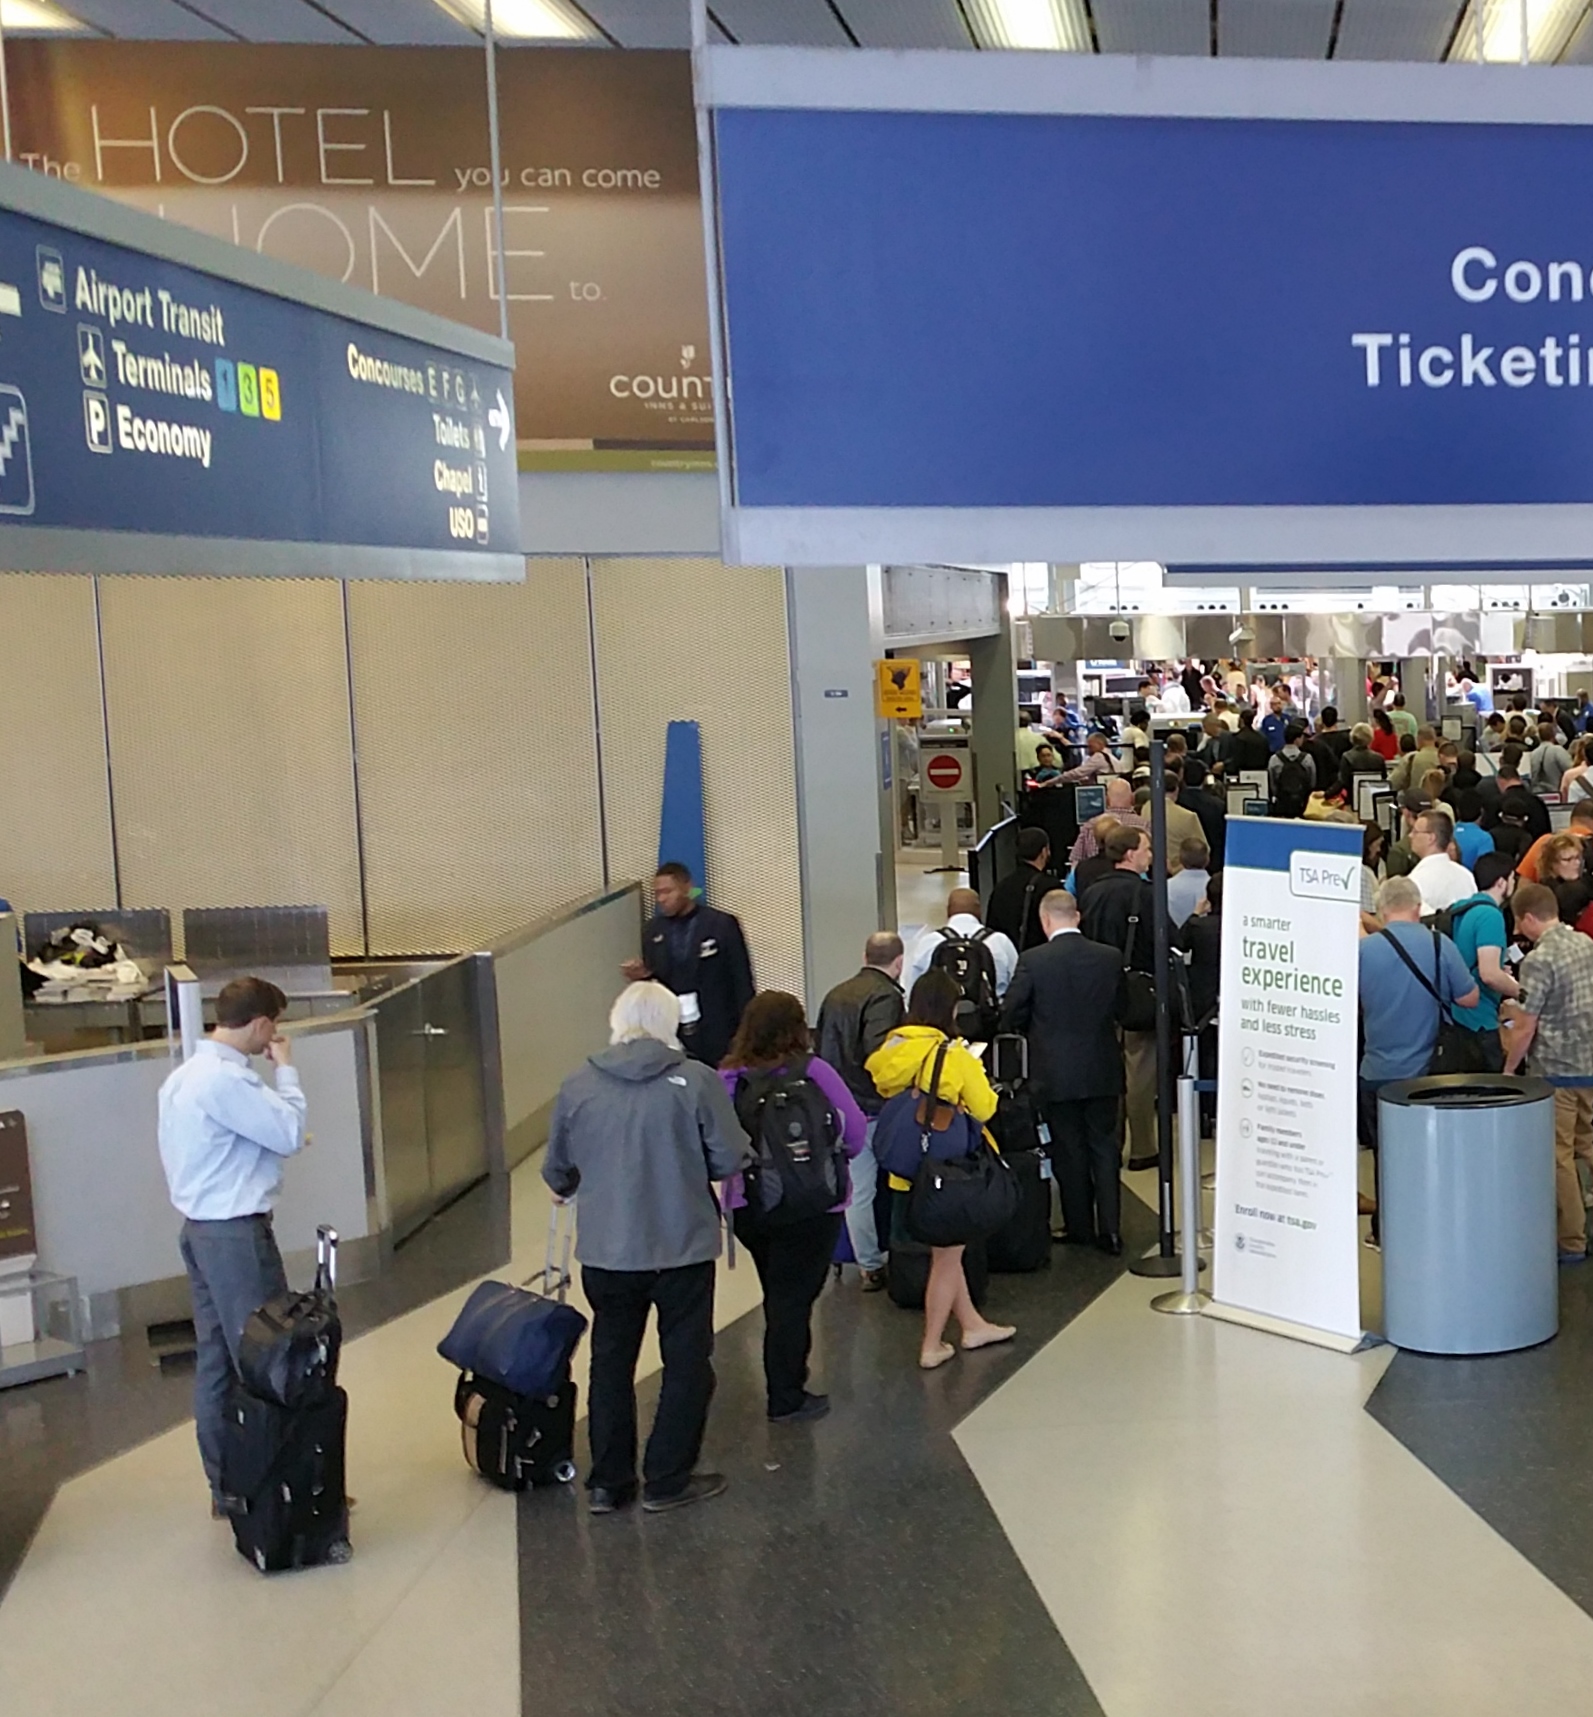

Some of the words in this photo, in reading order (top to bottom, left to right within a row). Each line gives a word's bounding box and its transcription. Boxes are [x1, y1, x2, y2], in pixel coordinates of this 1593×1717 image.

[19, 152, 81, 182] The
[91, 104, 436, 185] HOTEL
[455, 162, 509, 192] you
[520, 165, 572, 188] can
[581, 165, 661, 190] come
[75, 264, 154, 329] Airport
[158, 288, 225, 347] Transit
[111, 338, 213, 402] Terminals
[242, 373, 254, 405] 3
[265, 377, 275, 409] 5
[347, 342, 424, 396] Concourses
[427, 366, 438, 398] E
[442, 370, 450, 400] F
[455, 373, 465, 404] G
[116, 403, 212, 469] Economy
[432, 412, 471, 450] Toilets
[434, 458, 473, 499] Chapel
[449, 506, 475, 540] USO
[1299, 866, 1320, 884] TSA
[1321, 869, 1342, 887] Pre
[1242, 915, 1249, 927] a
[1251, 916, 1291, 932] smarter
[1242, 935, 1295, 963] travel
[1241, 966, 1344, 997] experience
[1241, 997, 1265, 1013] with
[1267, 1000, 1298, 1018] fewer
[1300, 1004, 1341, 1024] hassles
[1240, 1016, 1260, 1032] and
[1262, 1018, 1283, 1036] less
[1284, 1022, 1317, 1041] stress
[1234, 1203, 1258, 1218] Enroll
[1259, 1209, 1276, 1222] now
[1286, 1215, 1318, 1231] tsa.gov
